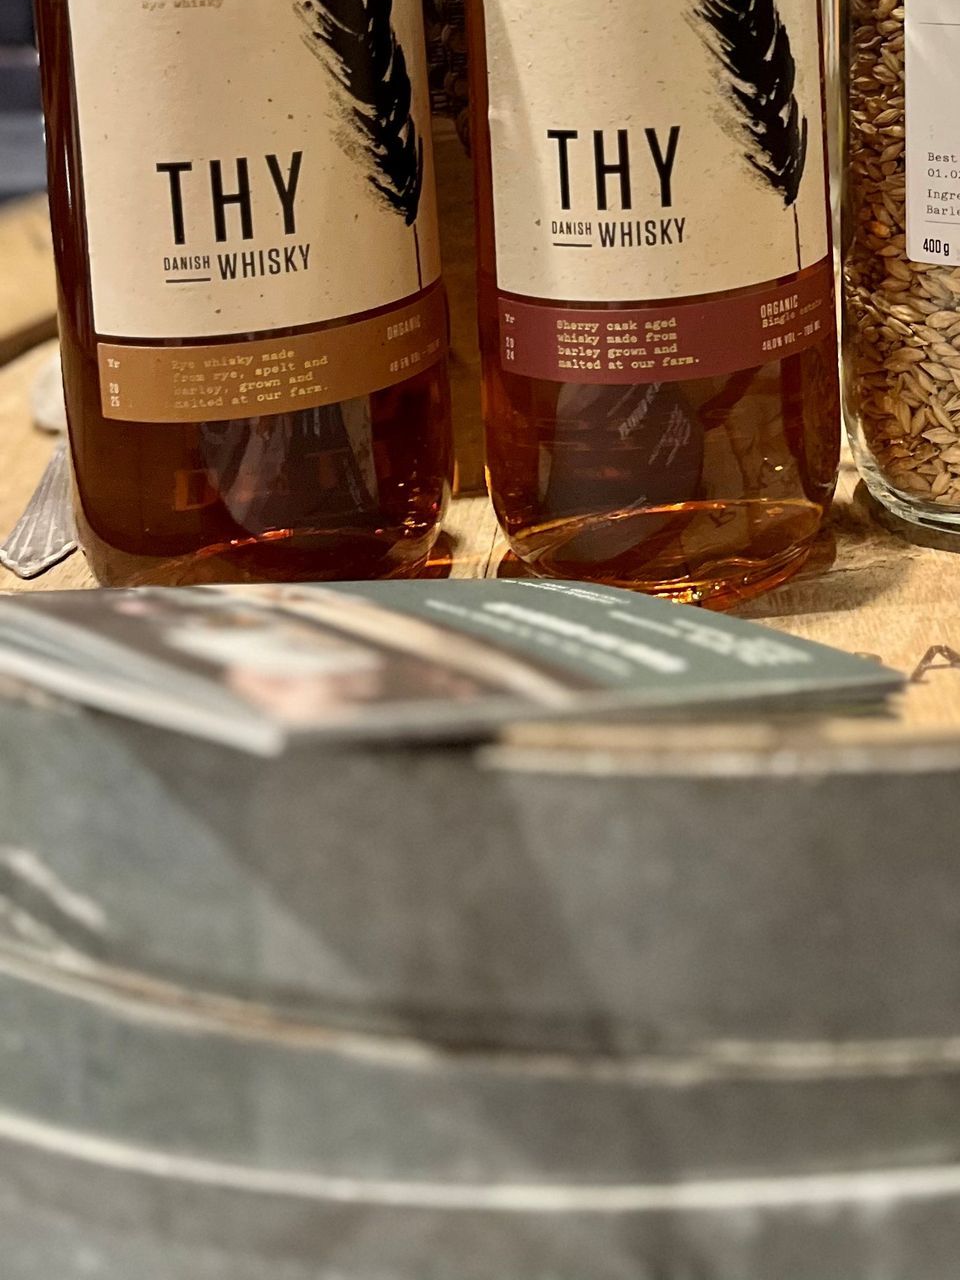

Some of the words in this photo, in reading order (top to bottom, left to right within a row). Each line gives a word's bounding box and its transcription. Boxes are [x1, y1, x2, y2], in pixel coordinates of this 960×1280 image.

[547, 125, 681, 211] THY
[927, 151, 958, 164] Best
[156, 150, 303, 245] THY
[551, 220, 592, 236] DANISH
[598, 217, 686, 248] WHISKY
[922, 238, 942, 254] 400
[943, 242, 950, 257] g
[163, 254, 211, 271] DANISH
[217, 243, 311, 280] WHISKY
[760, 294, 798, 318] ORGANIC
[556, 319, 600, 333] Sherry
[606, 320, 638, 331] cask
[644, 317, 677, 331] aged
[556, 333, 600, 346] whisky
[606, 334, 638, 344] made
[645, 332, 678, 342] from
[204, 354, 253, 368] whisky
[262, 349, 295, 362] made
[557, 345, 600, 359] barley
[607, 348, 647, 358] grown
[654, 343, 678, 354] and
[255, 362, 296, 377] spelt
[304, 355, 328, 368] and
[558, 359, 602, 369] malted
[608, 360, 624, 369] at
[631, 360, 656, 369] our
[662, 356, 700, 367] farm.
[239, 378, 281, 393] grown
[289, 371, 314, 384] and
[231, 395, 249, 406] at
[257, 391, 282, 402] our
[289, 384, 328, 397] farm.
